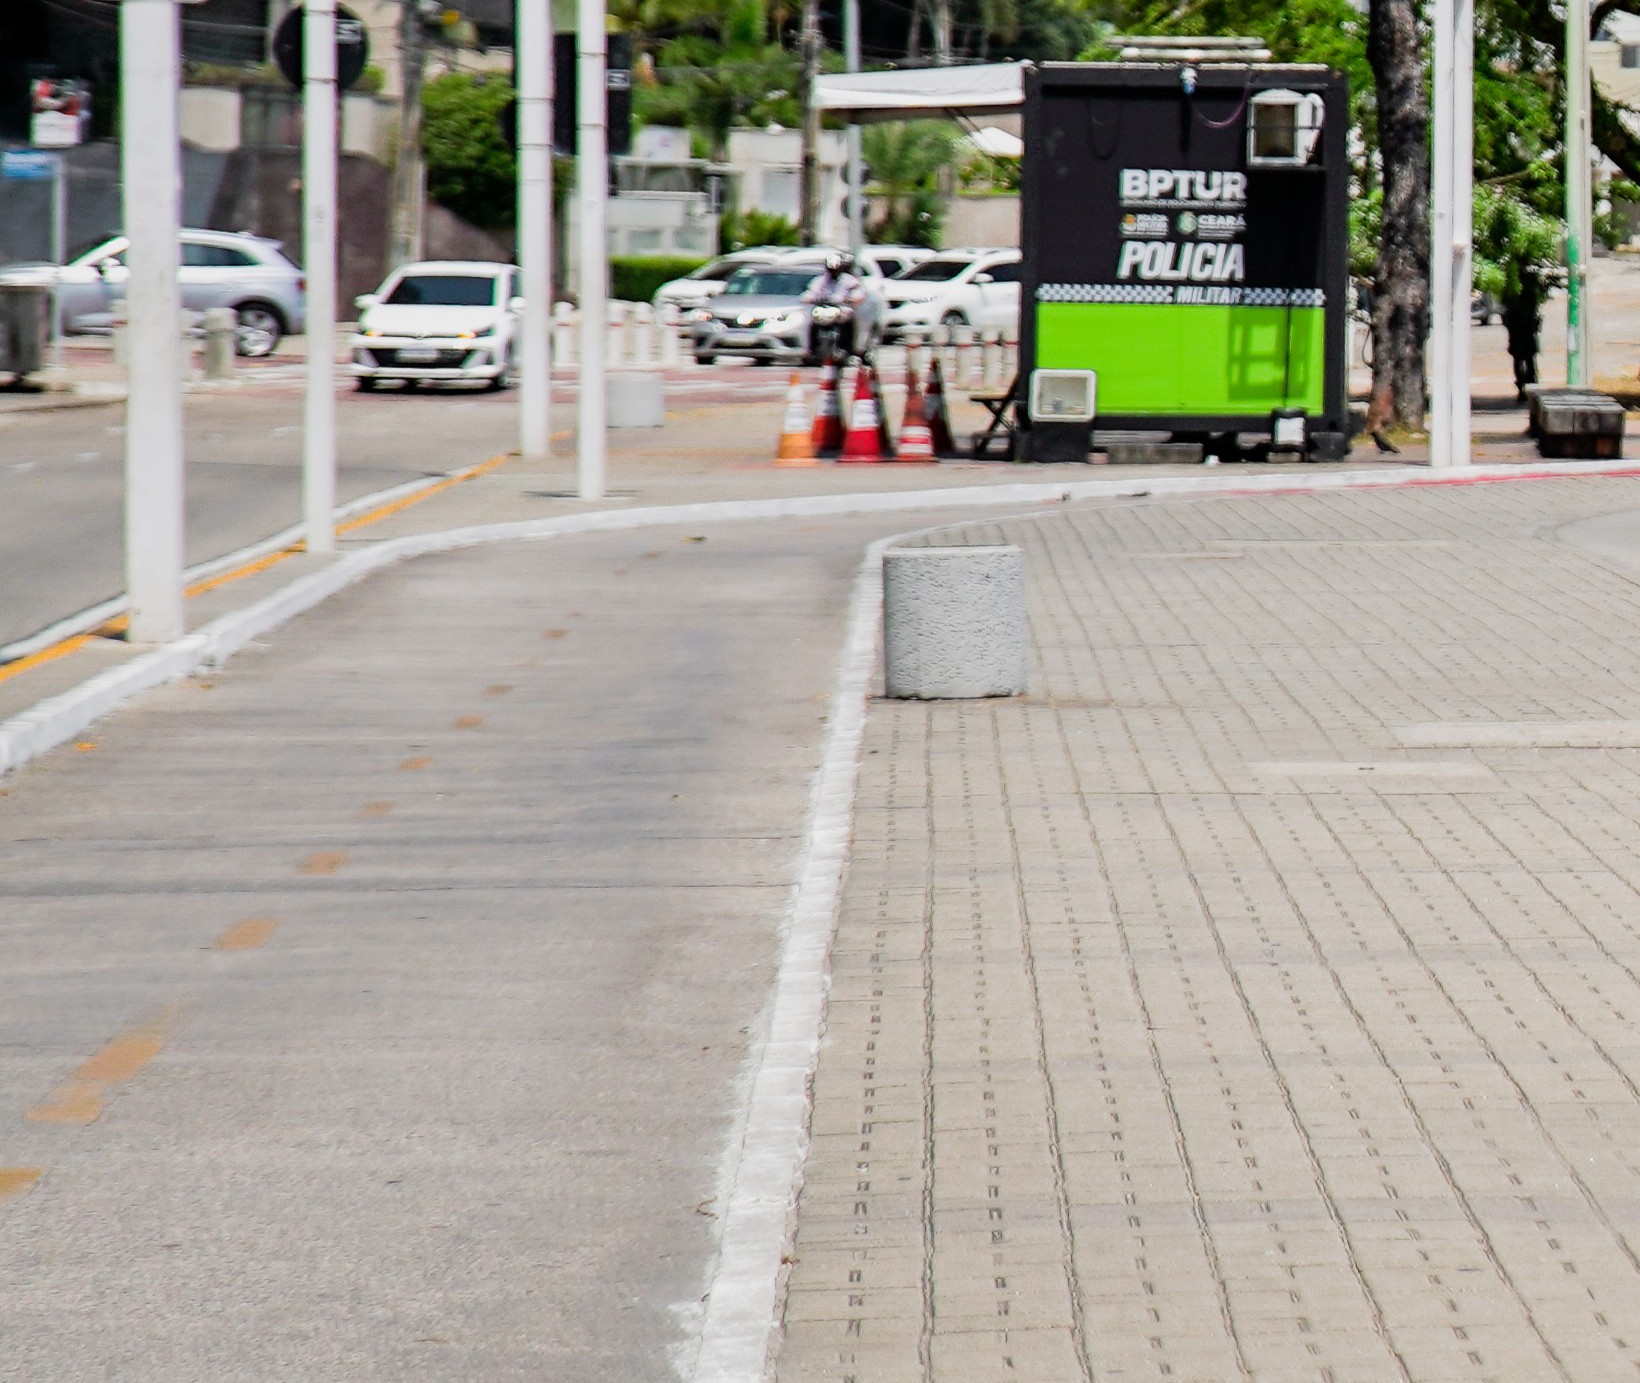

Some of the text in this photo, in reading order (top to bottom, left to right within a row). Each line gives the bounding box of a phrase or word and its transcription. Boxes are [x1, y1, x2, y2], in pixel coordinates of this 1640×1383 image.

[1119, 168, 1247, 200] BPTUR
[1198, 213, 1247, 227] CEARÁ
[1117, 240, 1245, 282] POLICIA
[1175, 285, 1242, 304] MILITAR
